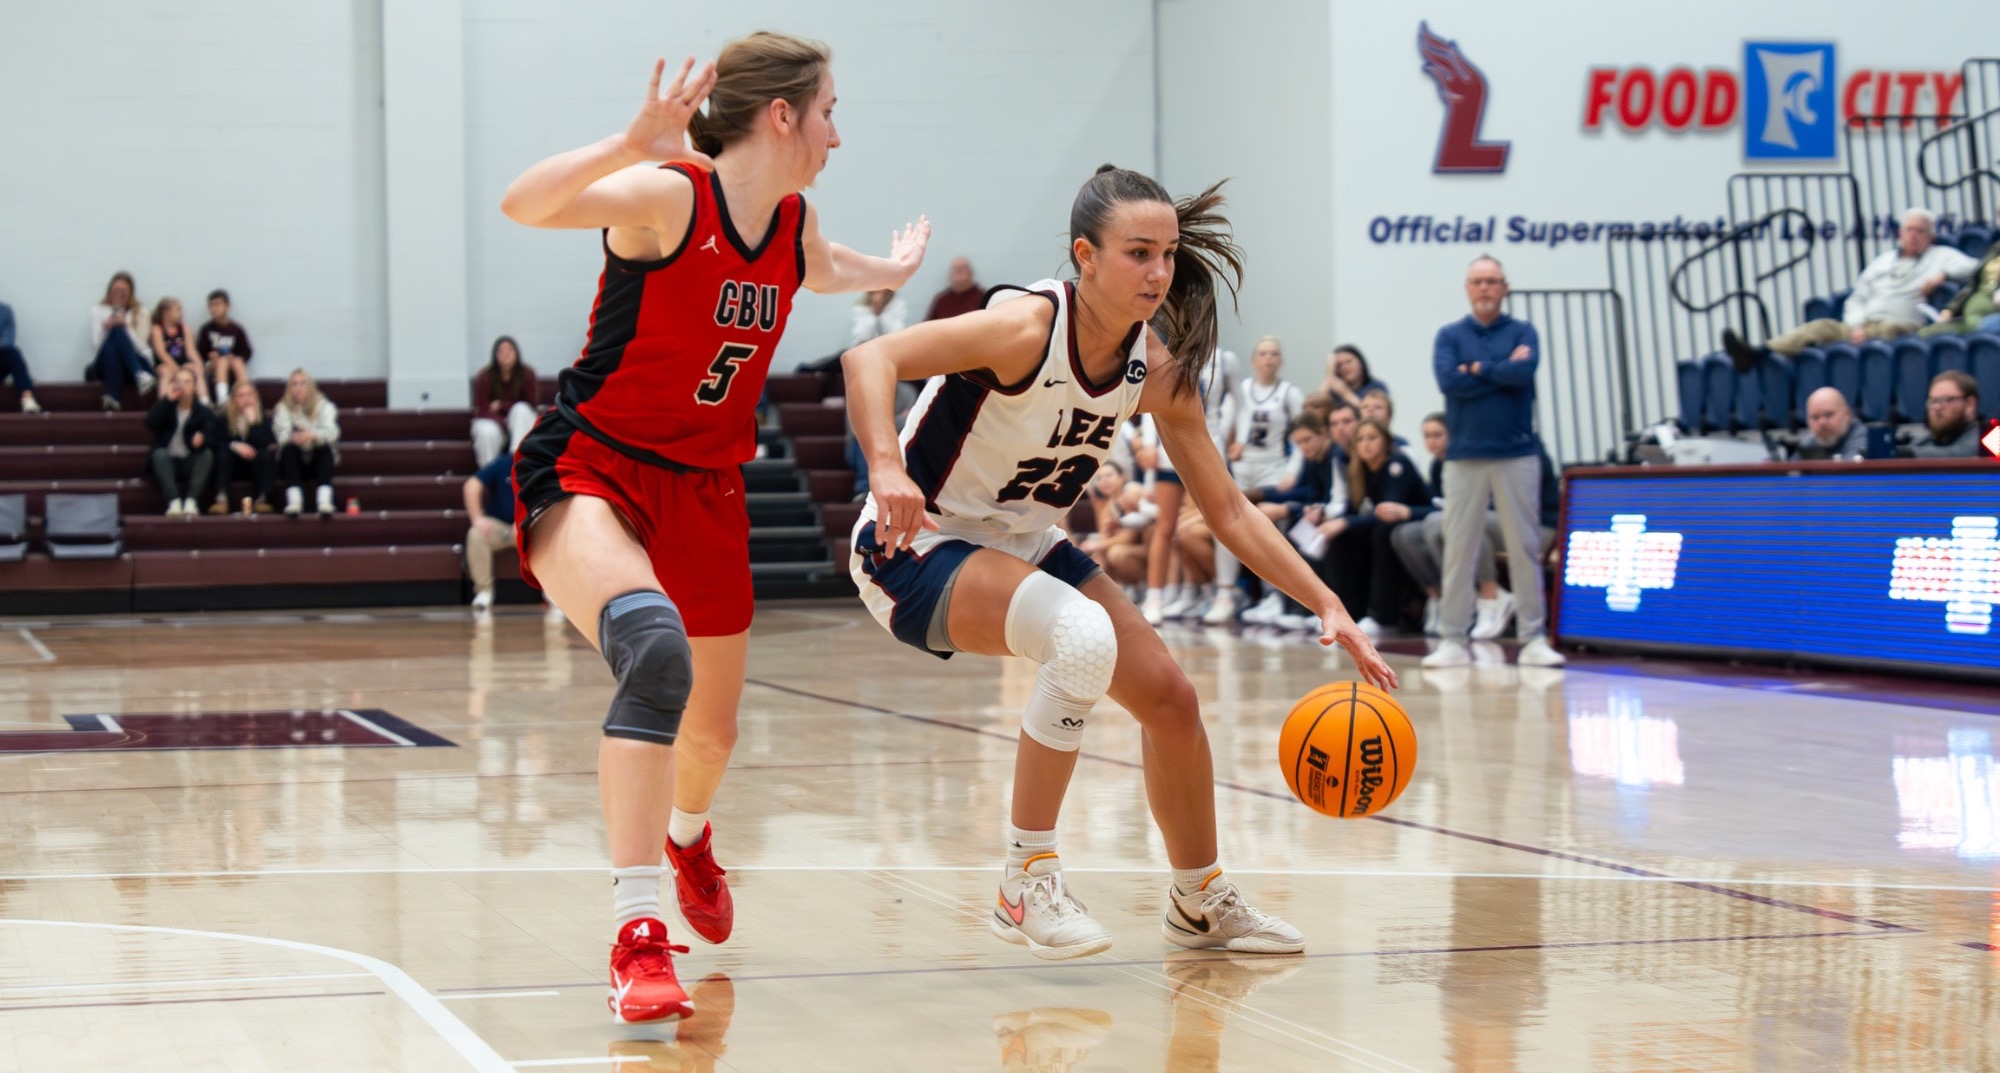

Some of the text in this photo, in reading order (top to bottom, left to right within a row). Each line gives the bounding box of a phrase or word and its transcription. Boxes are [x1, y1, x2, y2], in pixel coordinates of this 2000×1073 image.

[1583, 67, 1740, 130] FOOD
[1841, 69, 1964, 129] CITY
[1368, 215, 1496, 244] Official
[1505, 215, 1726, 249] Supermarket
[713, 279, 780, 332] CBU
[693, 341, 759, 406] 5
[1126, 364, 1146, 381] LC
[1046, 407, 1119, 450] LEE
[995, 453, 1101, 509] 23
[1351, 735, 1383, 816] Wilson
